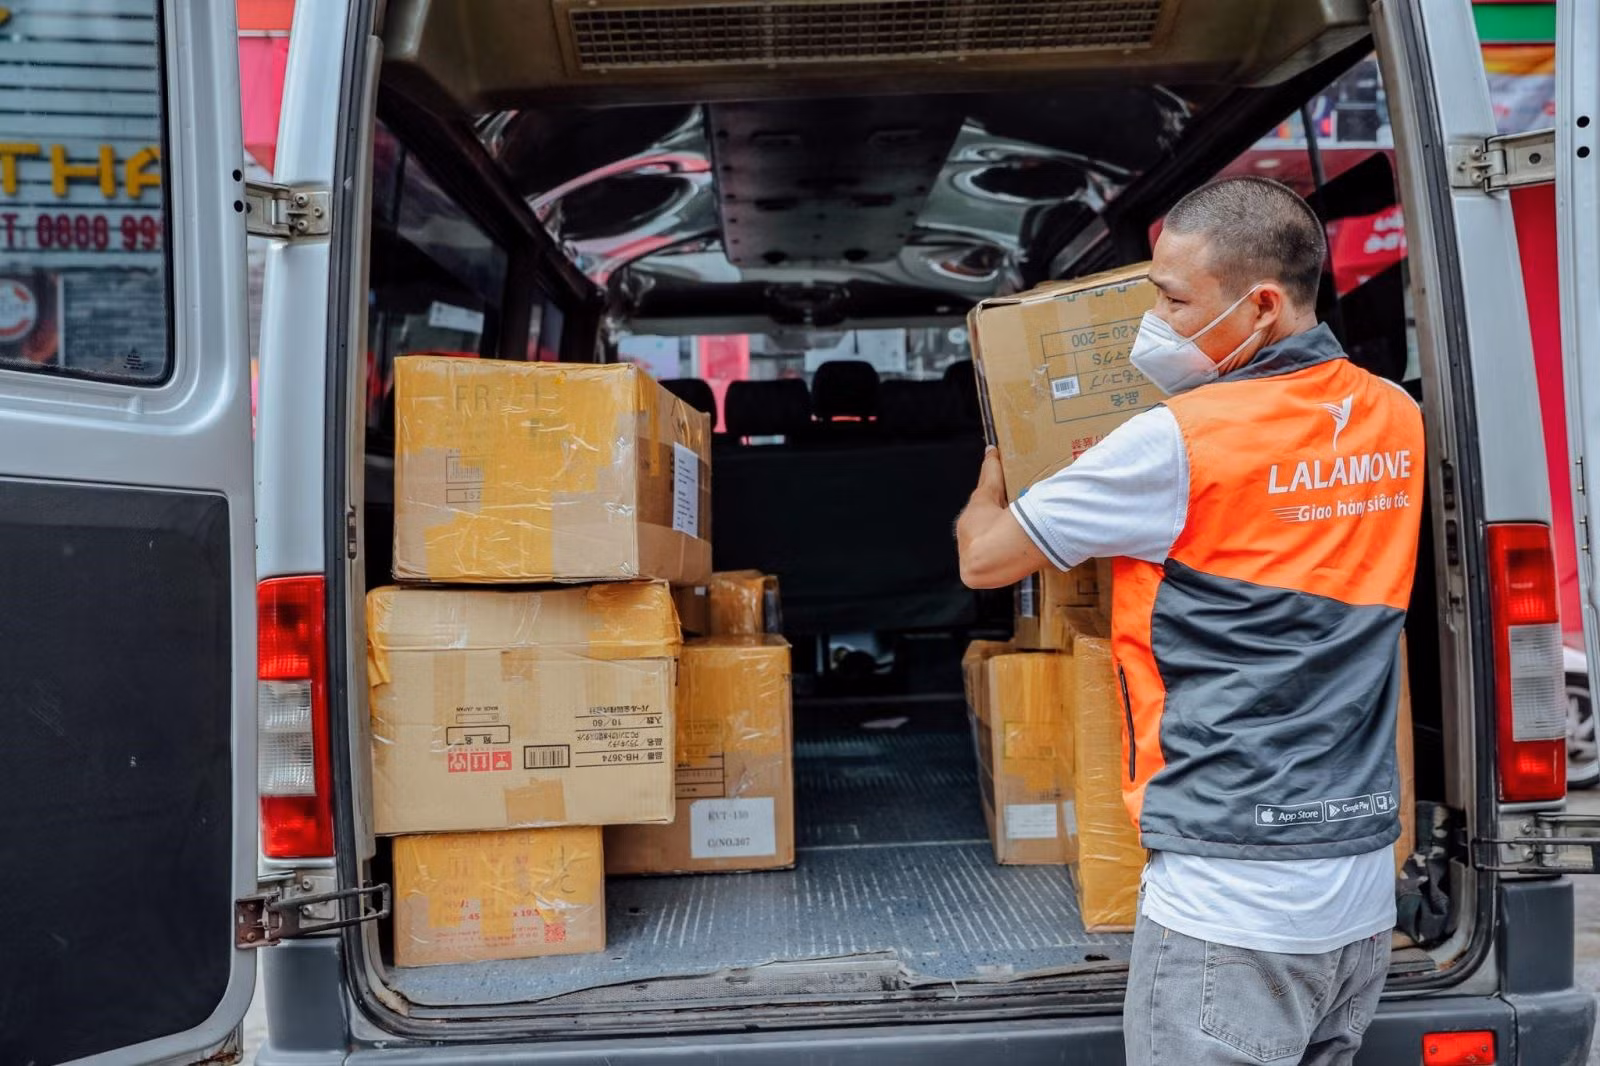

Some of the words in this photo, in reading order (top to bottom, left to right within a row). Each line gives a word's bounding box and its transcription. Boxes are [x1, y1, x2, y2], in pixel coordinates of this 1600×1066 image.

[1110, 391, 1139, 407] 品名
[1268, 450, 1410, 494] LALAMOVE
[1298, 506, 1332, 522] Giao
[1367, 493, 1392, 512] siêu
[1394, 490, 1409, 508] tốc
[1342, 803, 1359, 813] Google
[1359, 801, 1370, 811] Play
[1278, 811, 1297, 823] App
[1298, 810, 1319, 819] Store
